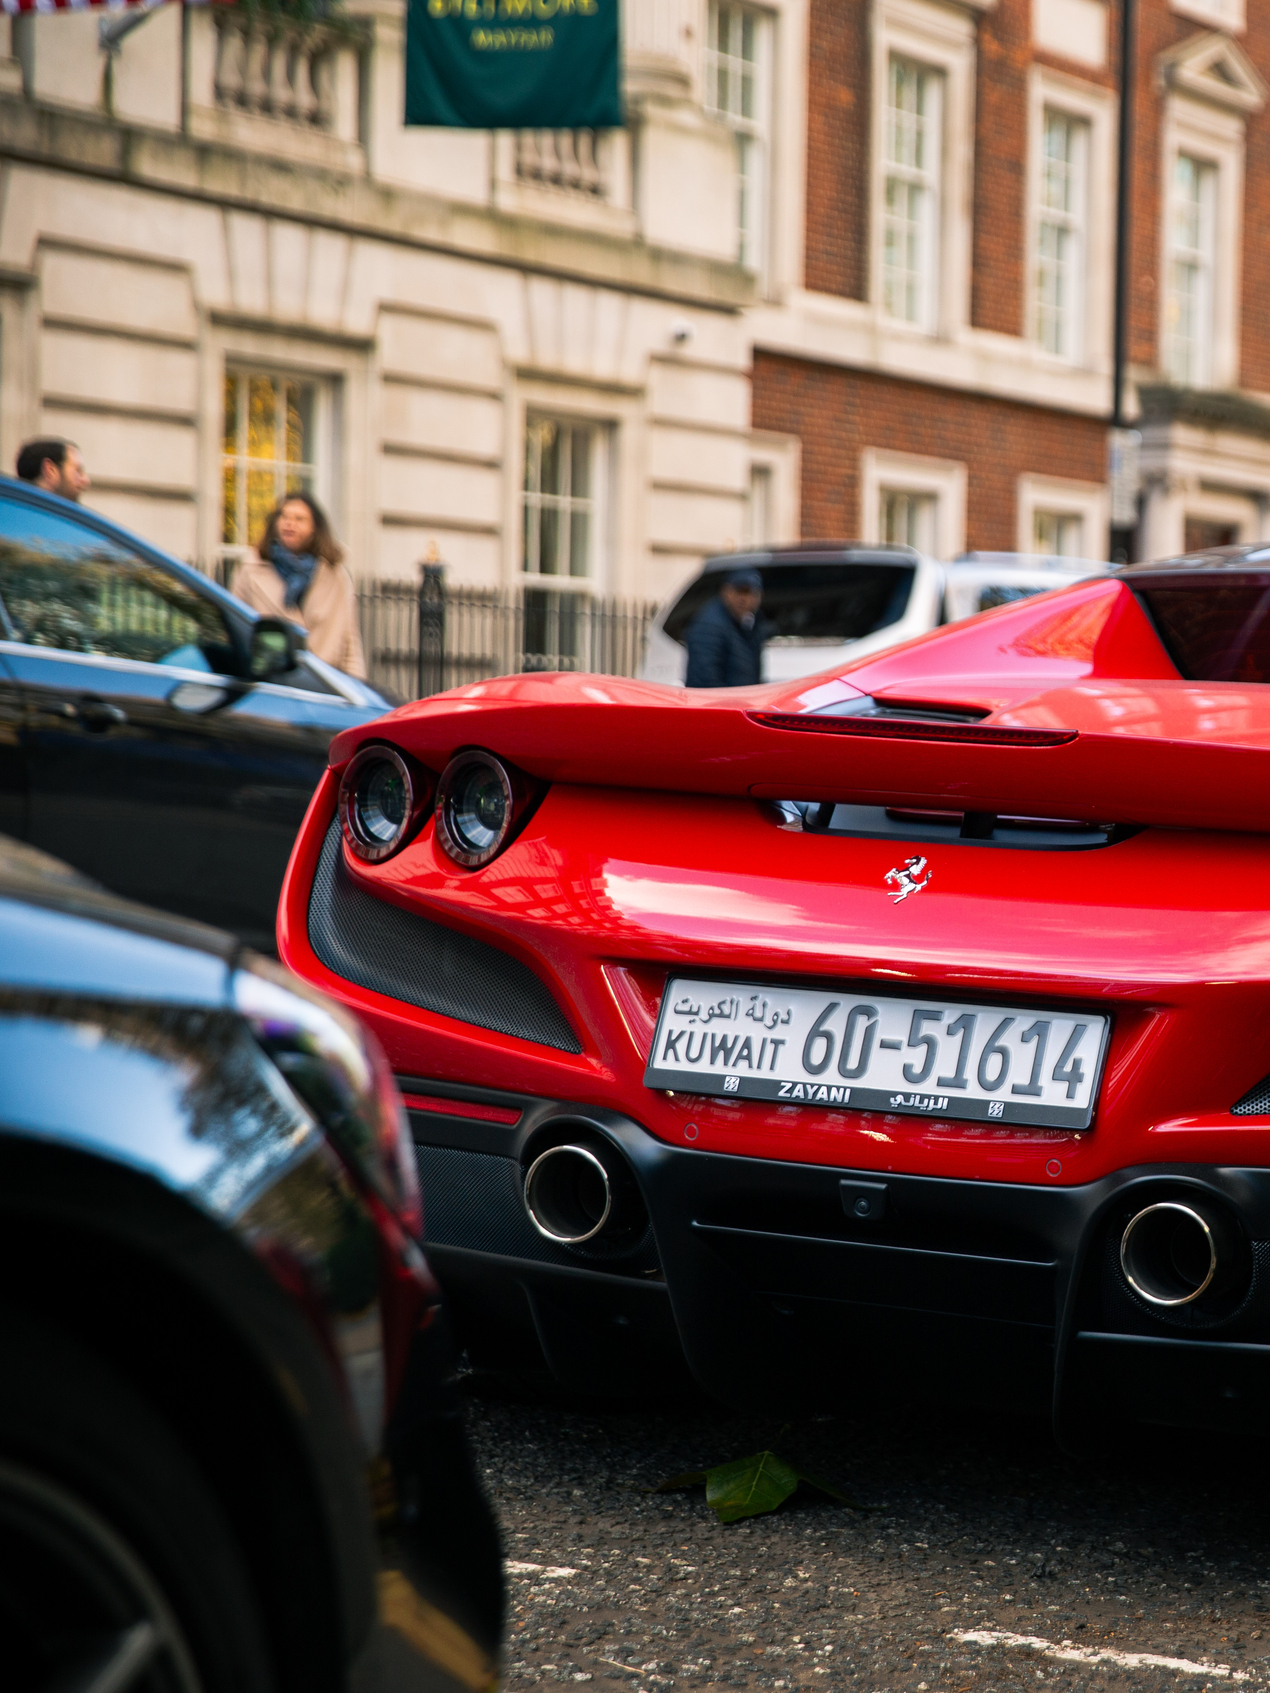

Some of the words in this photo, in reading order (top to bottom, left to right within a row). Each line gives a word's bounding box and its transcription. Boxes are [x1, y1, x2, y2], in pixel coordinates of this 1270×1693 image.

[469, 26, 555, 51] MAYFAIR
[673, 996, 741, 1025] الكويت
[745, 995, 792, 1030] دولة
[662, 1028, 787, 1072] KUWAIT
[802, 1001, 1086, 1099] 60-51614
[777, 1081, 852, 1104] ZAYANI
[889, 1094, 949, 1111] الزياني
